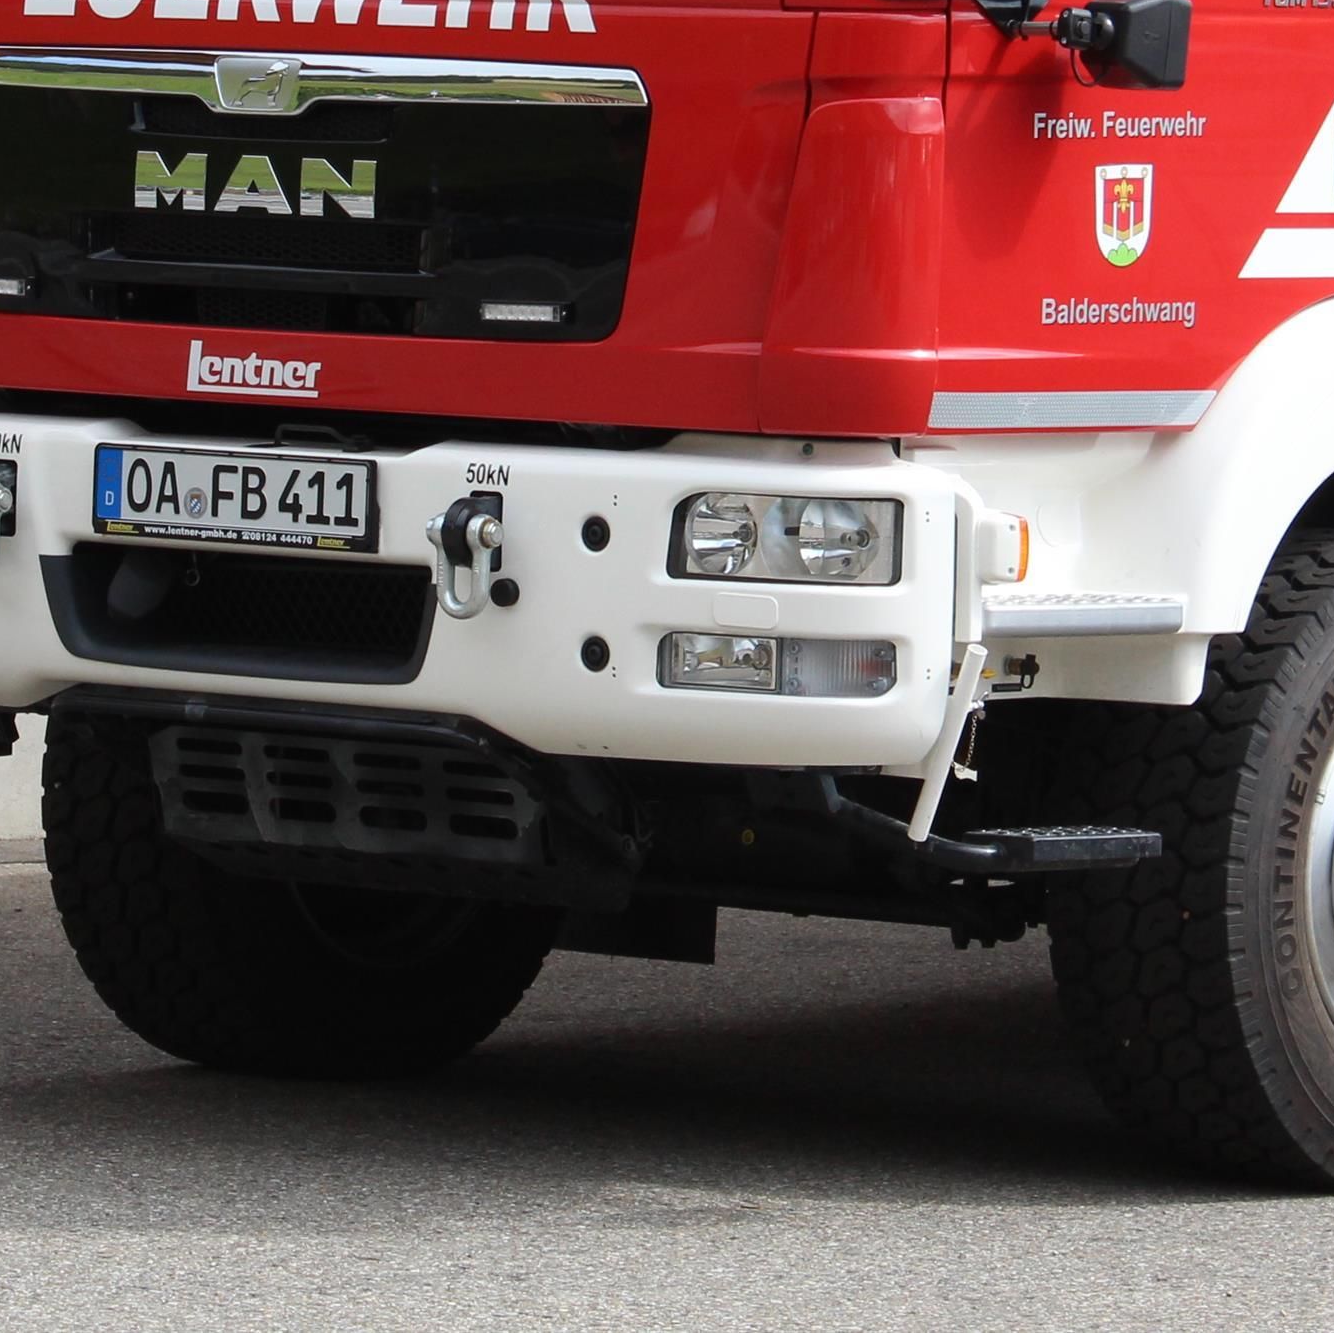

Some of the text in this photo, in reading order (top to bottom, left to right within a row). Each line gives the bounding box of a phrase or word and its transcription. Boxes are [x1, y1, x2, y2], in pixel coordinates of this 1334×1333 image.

[1032, 110, 1207, 139] Freiw. Feuerwehr
[133, 150, 377, 220] MAN
[1041, 297, 1196, 328] Balderschwang
[465, 462, 510, 486] 50kN
[105, 490, 114, 506] D
[126, 457, 359, 527] OA FB 411
[144, 526, 237, 540] www.lentner-gmbh.de
[280, 534, 313, 545] 444470
